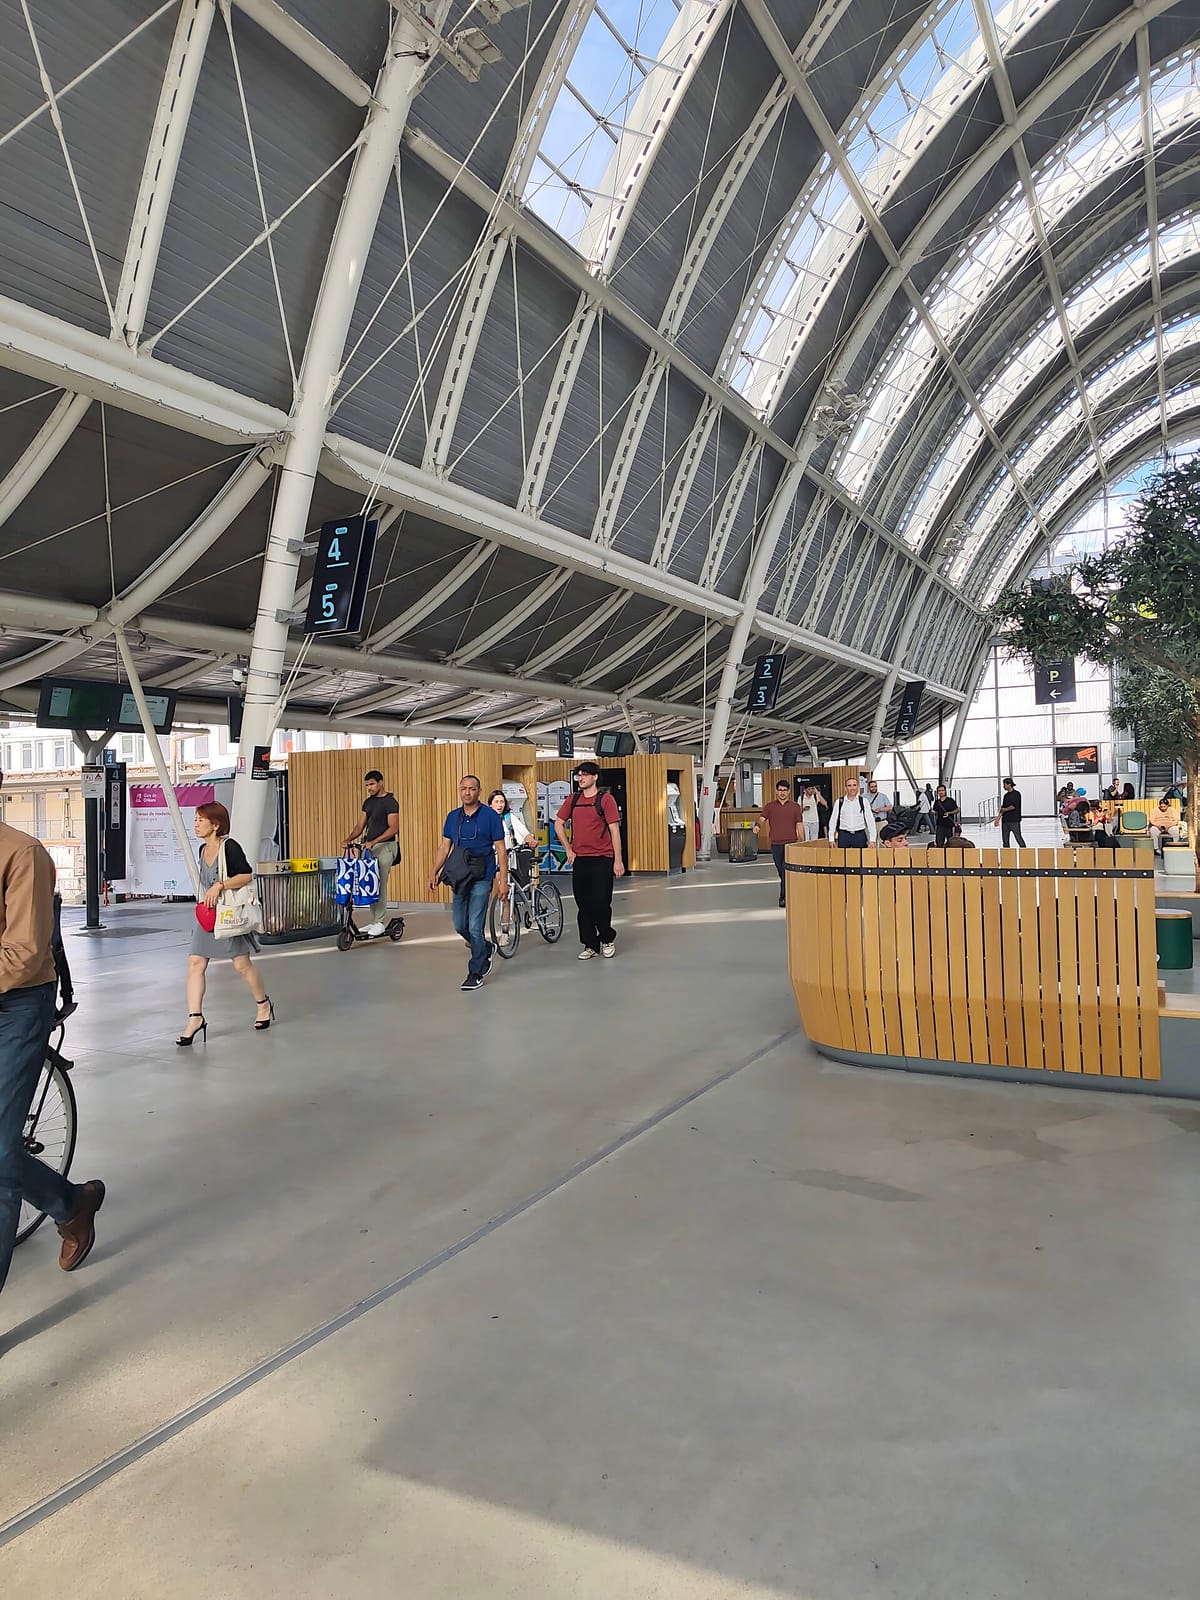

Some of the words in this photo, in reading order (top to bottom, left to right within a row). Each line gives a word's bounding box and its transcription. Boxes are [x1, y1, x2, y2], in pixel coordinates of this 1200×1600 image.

[328, 537, 341, 561] 4
[322, 593, 335, 617] 5
[763, 663, 772, 676] 2
[1049, 670, 1060, 682] P
[757, 690, 765, 703] 3
[906, 704, 912, 713] 1
[900, 723, 909, 731] G
[564, 736, 571, 752] 3
[107, 754, 113, 764] 4
[112, 769, 119, 780] 4
